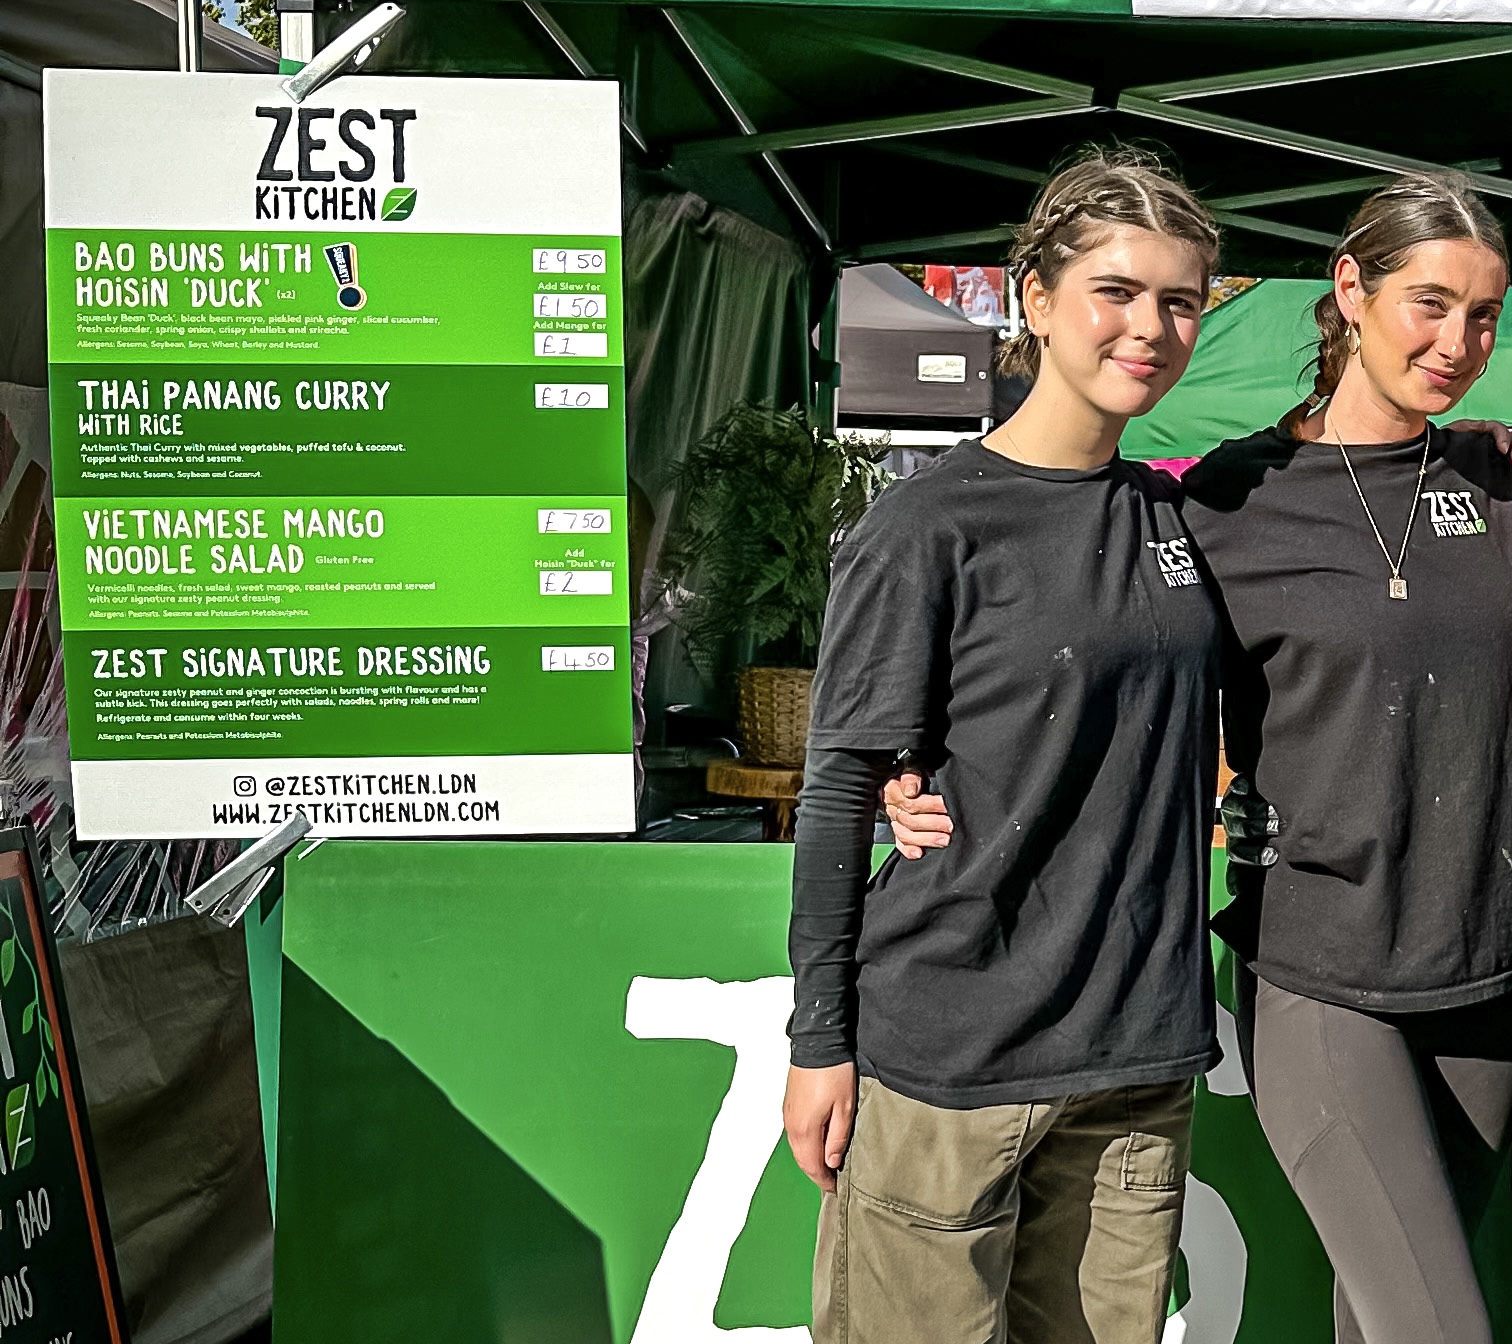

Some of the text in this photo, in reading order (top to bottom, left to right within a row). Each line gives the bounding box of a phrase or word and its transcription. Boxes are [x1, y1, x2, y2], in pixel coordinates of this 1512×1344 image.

[255, 106, 417, 183] ZEST
[74, 241, 135, 272] BAO
[150, 241, 225, 273] BUNS
[184, 278, 270, 308] 'DUCK'
[538, 282, 601, 291] Add Slaw for
[121, 313, 324, 324] Bean black bean pickled pink
[533, 321, 607, 332] Add Mango for
[218, 325, 306, 335] crispy and
[543, 335, 577, 356] £1
[163, 380, 281, 410] PANANG
[296, 381, 391, 411] CURRY
[542, 387, 591, 408] £10
[80, 443, 354, 454] Authentic Thai Curry with mixed puffed tofu
[80, 454, 205, 465] Topped with cashews and
[1421, 491, 1479, 523] ZEST
[283, 509, 385, 539] MANGO
[85, 543, 374, 575] NOODLE SALAD Gluten Free
[565, 549, 585, 558] Add
[1146, 537, 1194, 573] ZES
[534, 560, 564, 568] Hoisin
[600, 560, 616, 568] for
[304, 582, 436, 593] roasted peanuts and served
[545, 571, 578, 593] £2
[88, 595, 240, 605] with peanut
[91, 648, 168, 679] ZEST
[93, 685, 479, 698] Our signature zesty peanut and ginger concoction bursting with flavour and has
[95, 696, 450, 709] subtle This dressing goes perfectly with spring rolls and
[96, 712, 271, 724] Refrigerate and consume within four
[16, 1187, 50, 1249] BAO
